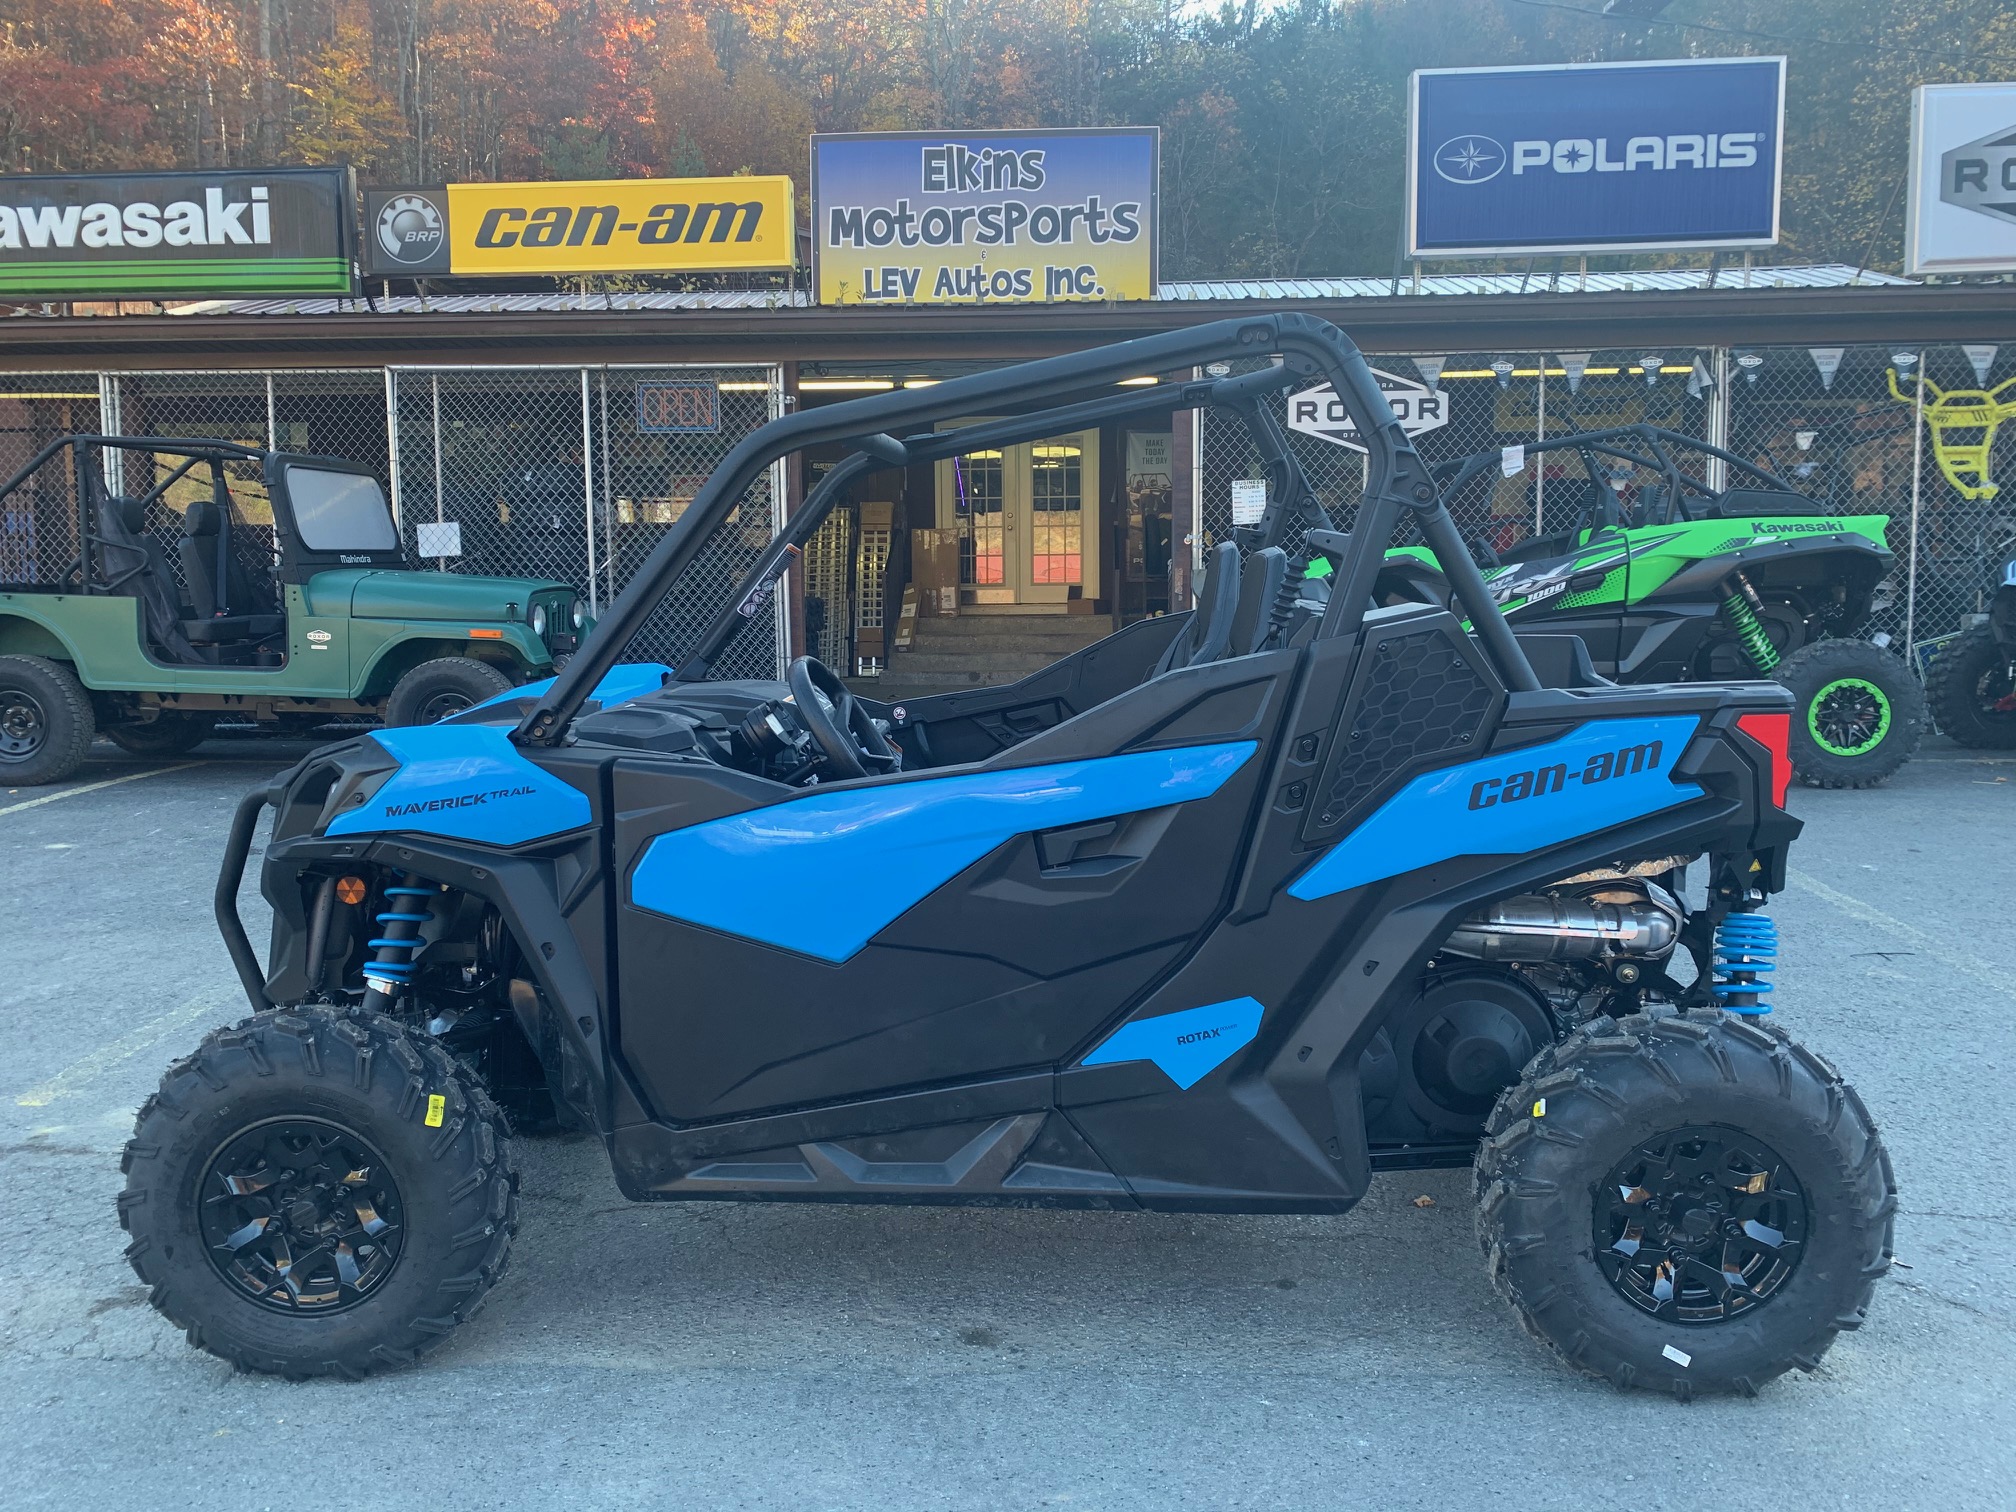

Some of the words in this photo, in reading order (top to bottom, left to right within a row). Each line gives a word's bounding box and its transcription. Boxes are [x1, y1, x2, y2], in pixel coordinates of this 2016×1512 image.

[1513, 133, 1757, 175] POLARIS
[921, 144, 1046, 193] Elkins
[475, 200, 764, 248] can-am
[404, 230, 440, 242] BRP
[863, 267, 921, 299] LEV
[933, 263, 1033, 298] Autos
[1044, 264, 1104, 297] Inc.
[643, 388, 713, 426] OPEN
[1296, 398, 1440, 422] ROOR
[1145, 439, 1164, 447] MAKE
[1145, 448, 1165, 456] TODAY
[1142, 457, 1154, 465] THE
[1155, 457, 1168, 465] DAY
[1751, 521, 1845, 534] Kawasaki
[340, 554, 371, 564] Mahindra
[1527, 581, 1567, 603] 1000
[1467, 740, 1663, 811] can-am
[385, 792, 489, 817] MAVERICK
[489, 786, 536, 799] TRAIL
[1177, 1028, 1220, 1046] ROTAX
